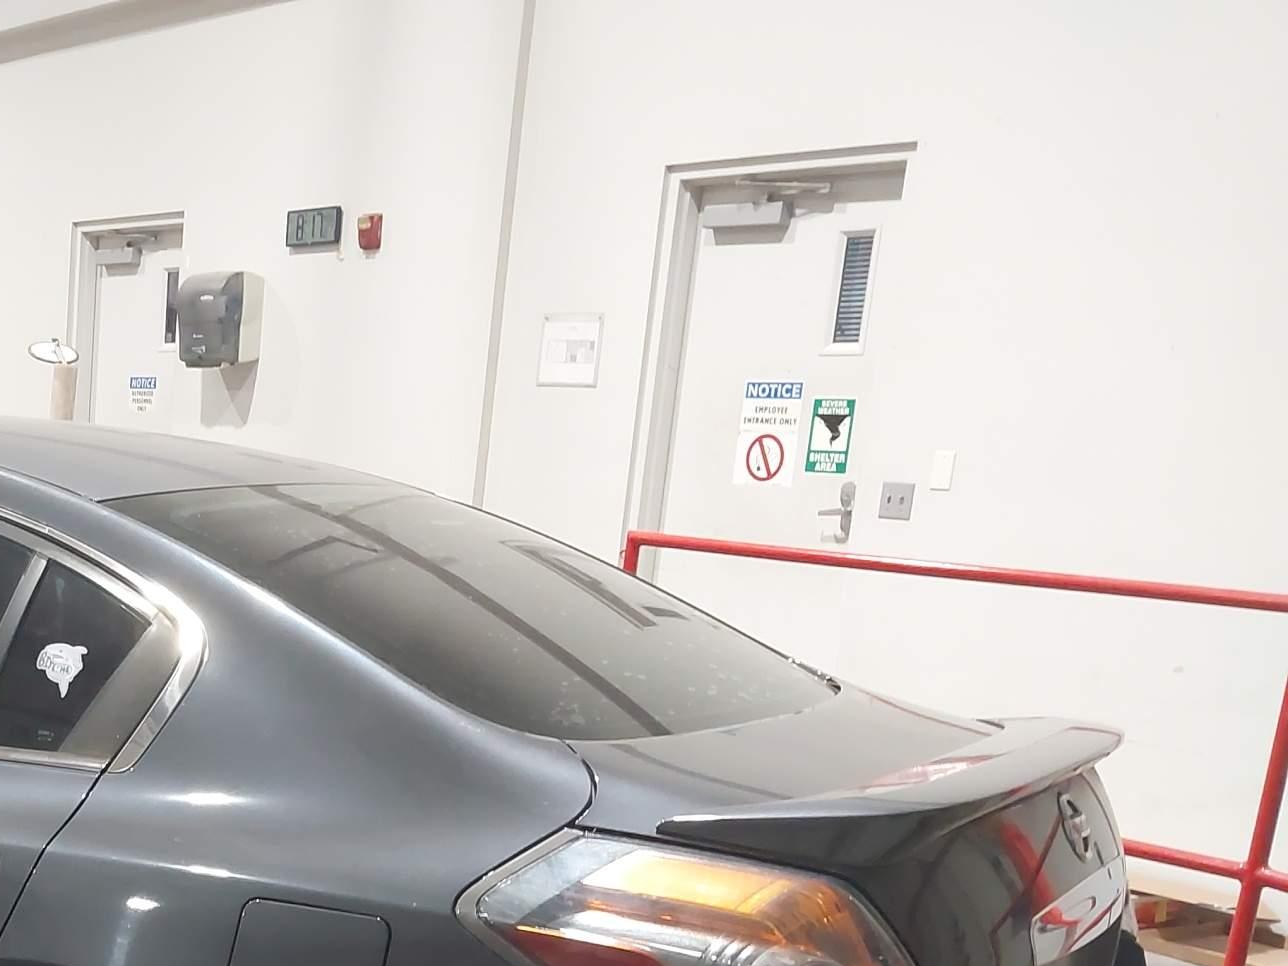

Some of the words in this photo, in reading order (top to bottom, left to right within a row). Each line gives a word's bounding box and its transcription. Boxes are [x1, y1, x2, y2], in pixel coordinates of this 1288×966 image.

[131, 378, 155, 388] NOTICE
[747, 383, 802, 398] NOTICE
[821, 400, 848, 408] SEVERE
[755, 406, 788, 414] EMPLOYEE
[818, 407, 850, 416] WEATHER
[743, 416, 777, 425] ENTRANCE
[779, 417, 798, 425] ONLY
[809, 452, 846, 463] SHELTER
[814, 462, 838, 472] AREA
